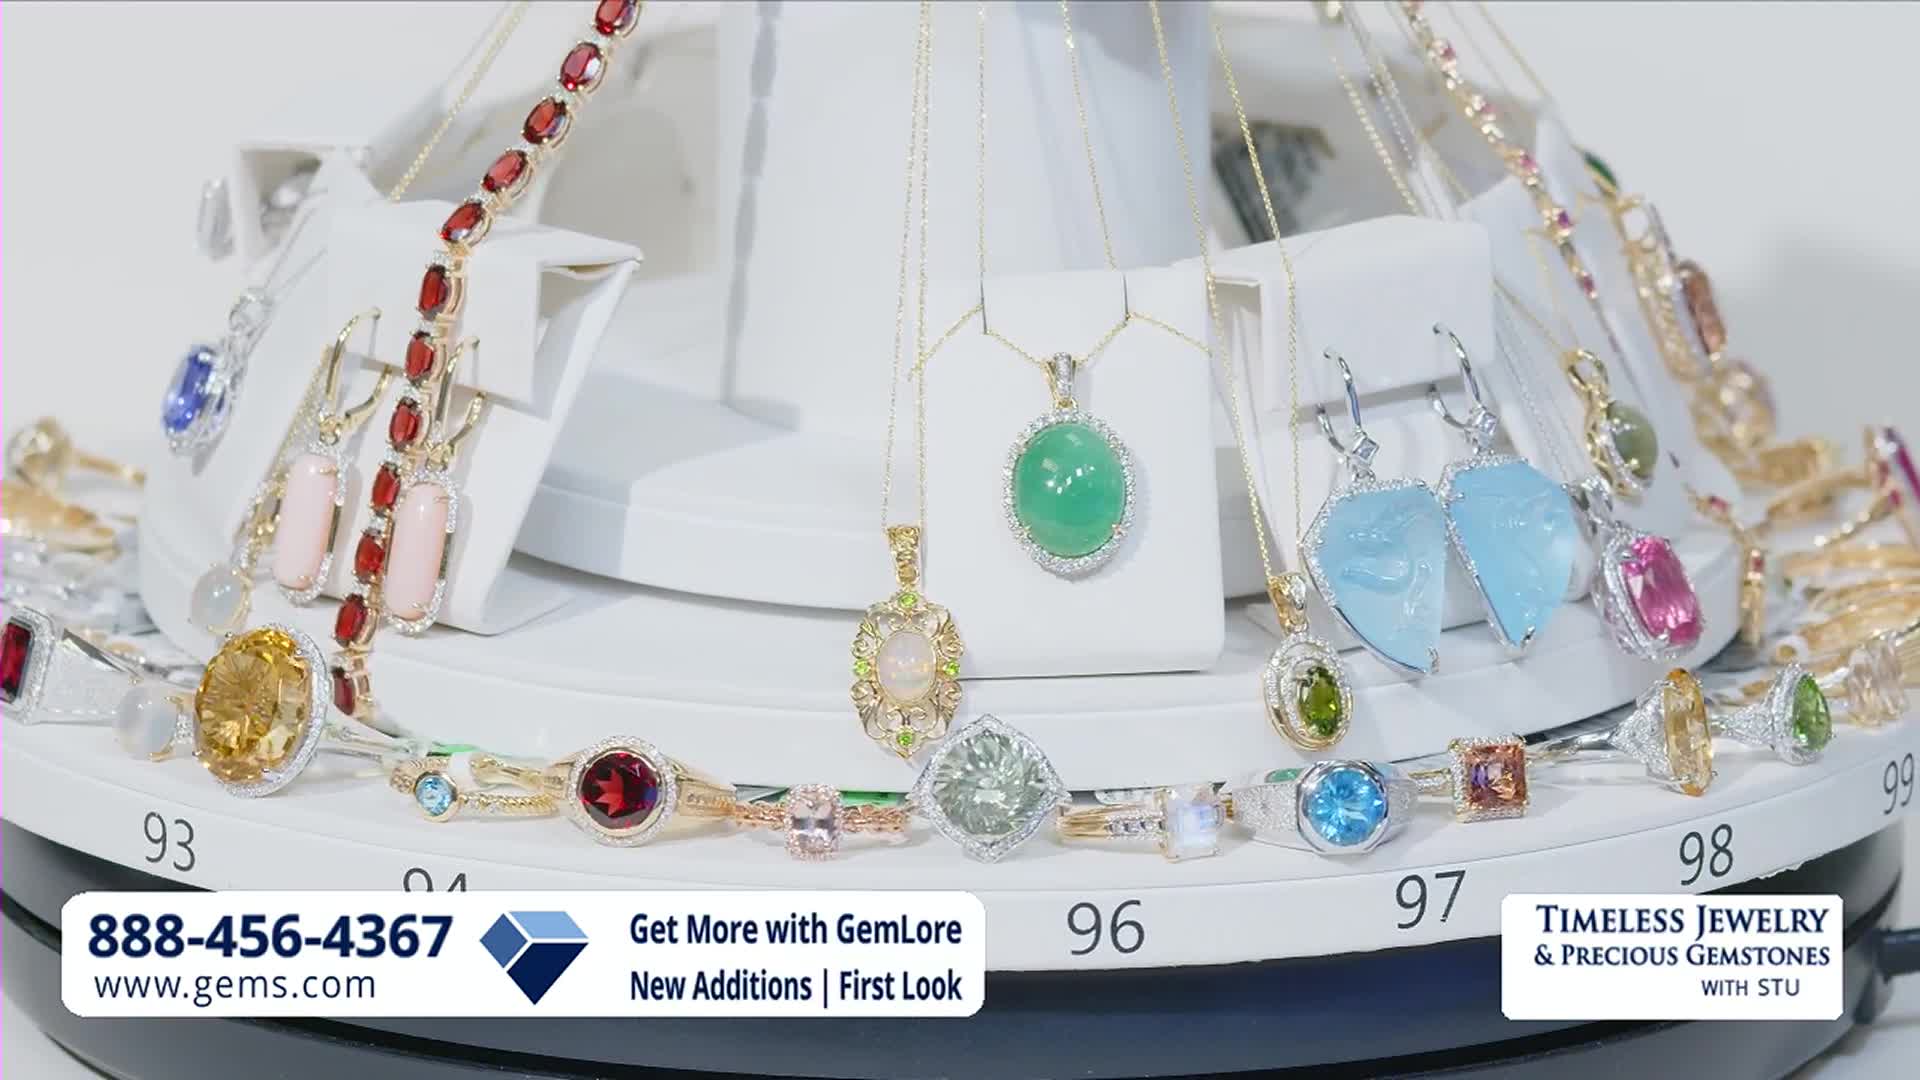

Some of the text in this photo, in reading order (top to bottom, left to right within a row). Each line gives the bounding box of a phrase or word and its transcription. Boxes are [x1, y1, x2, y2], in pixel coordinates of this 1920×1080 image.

[1883, 752, 1915, 815] 99
[142, 811, 196, 872] 93
[1679, 823, 1735, 886] 98
[1067, 899, 1145, 956] 96
[1395, 869, 1466, 930] 97
